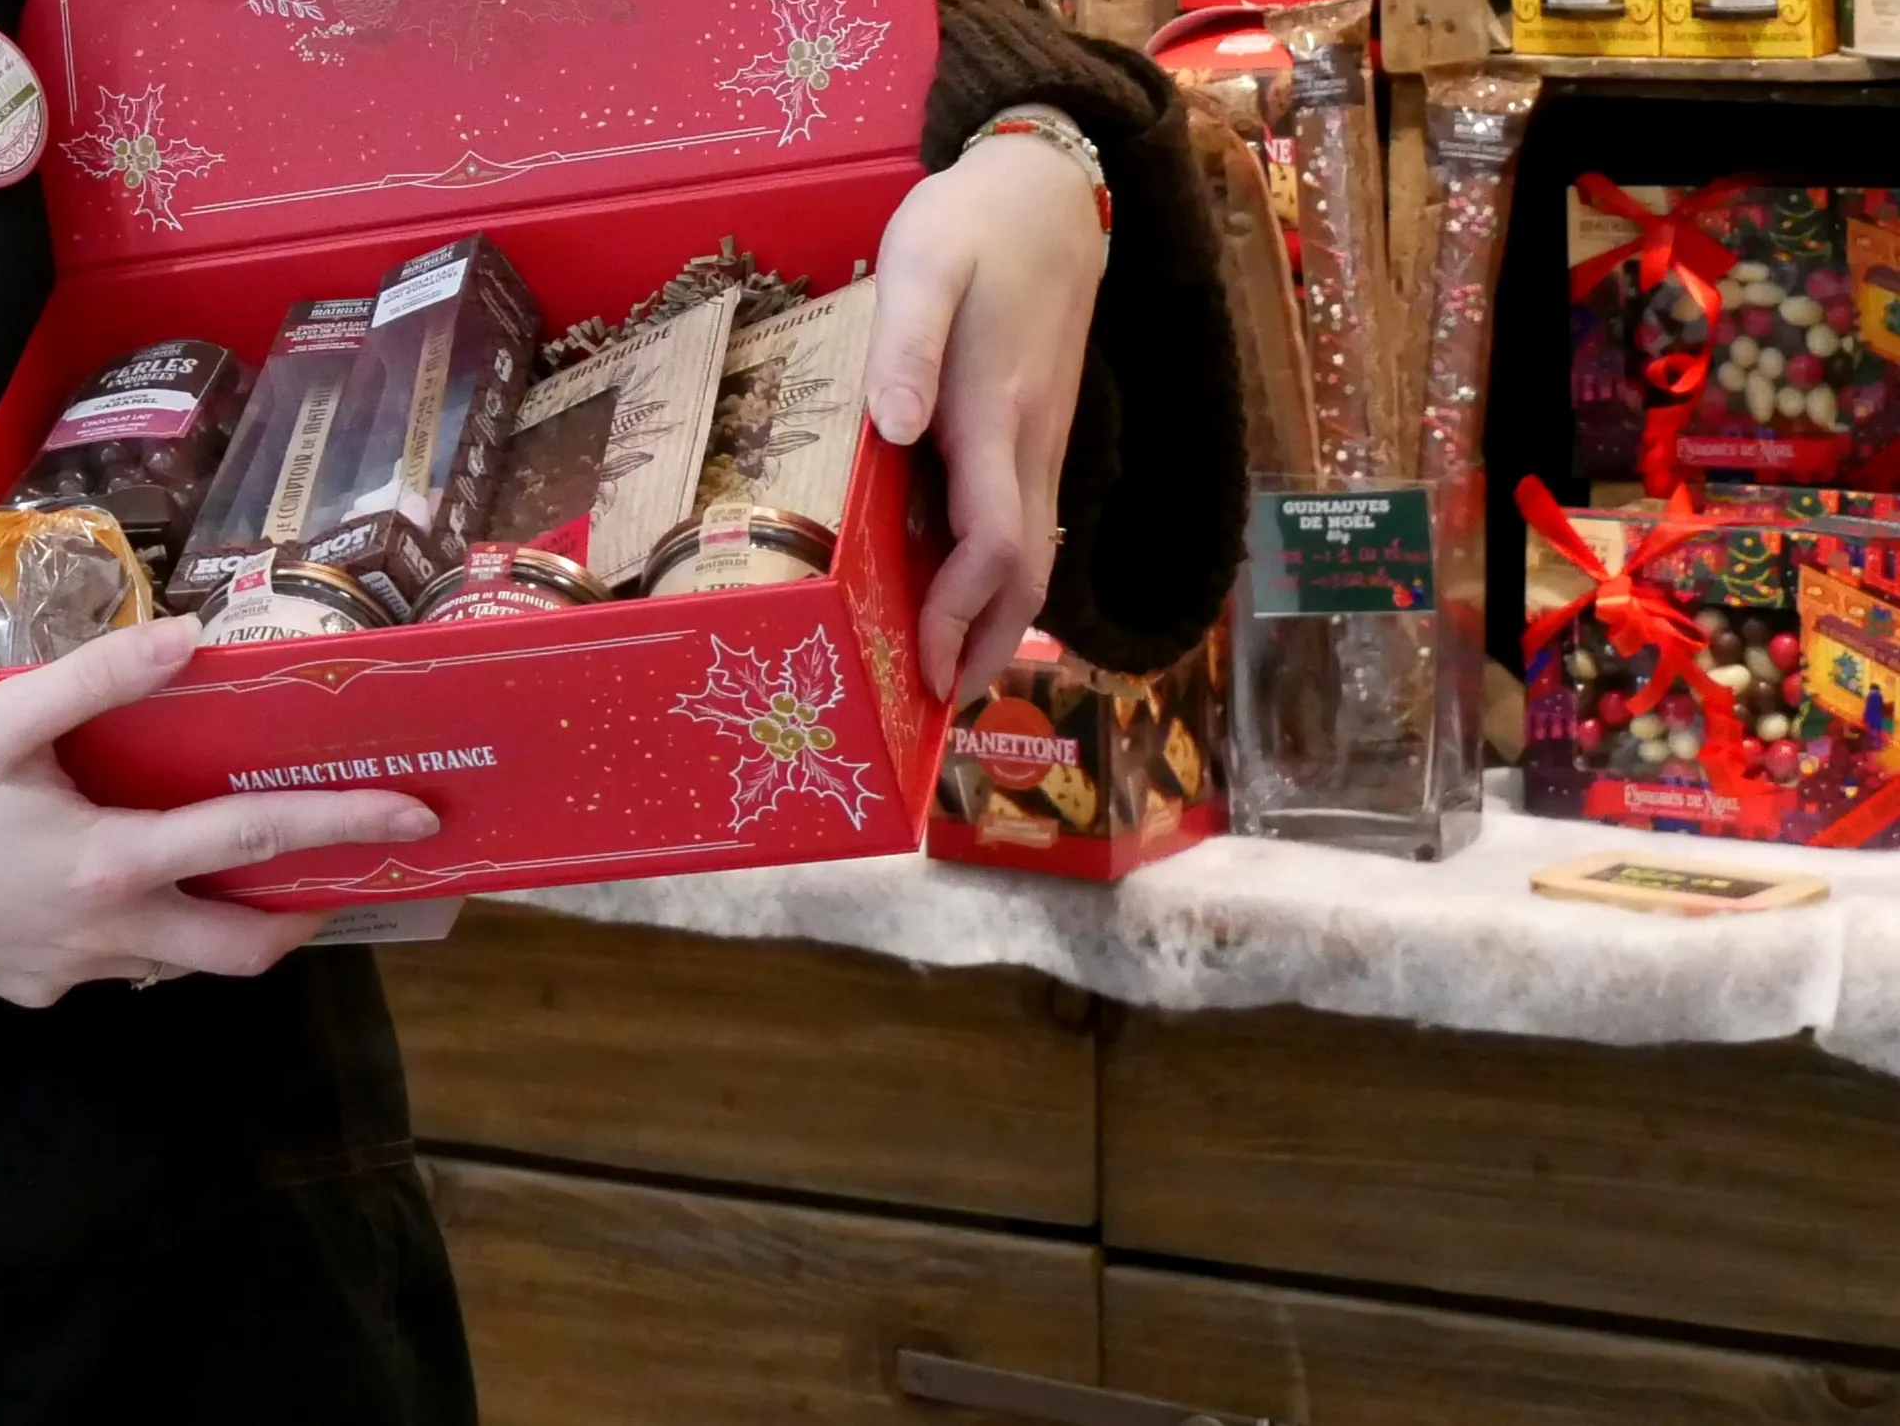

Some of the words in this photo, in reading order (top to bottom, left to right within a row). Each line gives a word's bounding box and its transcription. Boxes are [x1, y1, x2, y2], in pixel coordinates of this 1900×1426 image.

[311, 305, 370, 316] MATHILDE
[99, 357, 200, 385] PERLES
[94, 397, 158, 412] CARAMEL
[279, 455, 313, 521] COMPTOIR
[1282, 500, 1391, 515] GUIMAUVES
[1300, 516, 1323, 529] DE
[309, 524, 372, 562] HOT
[195, 555, 245, 574] HO
[955, 728, 1077, 766] PANETTONE
[228, 750, 382, 792] MANUFACTURE
[385, 750, 414, 776] EN
[418, 745, 498, 773] FRANCE
